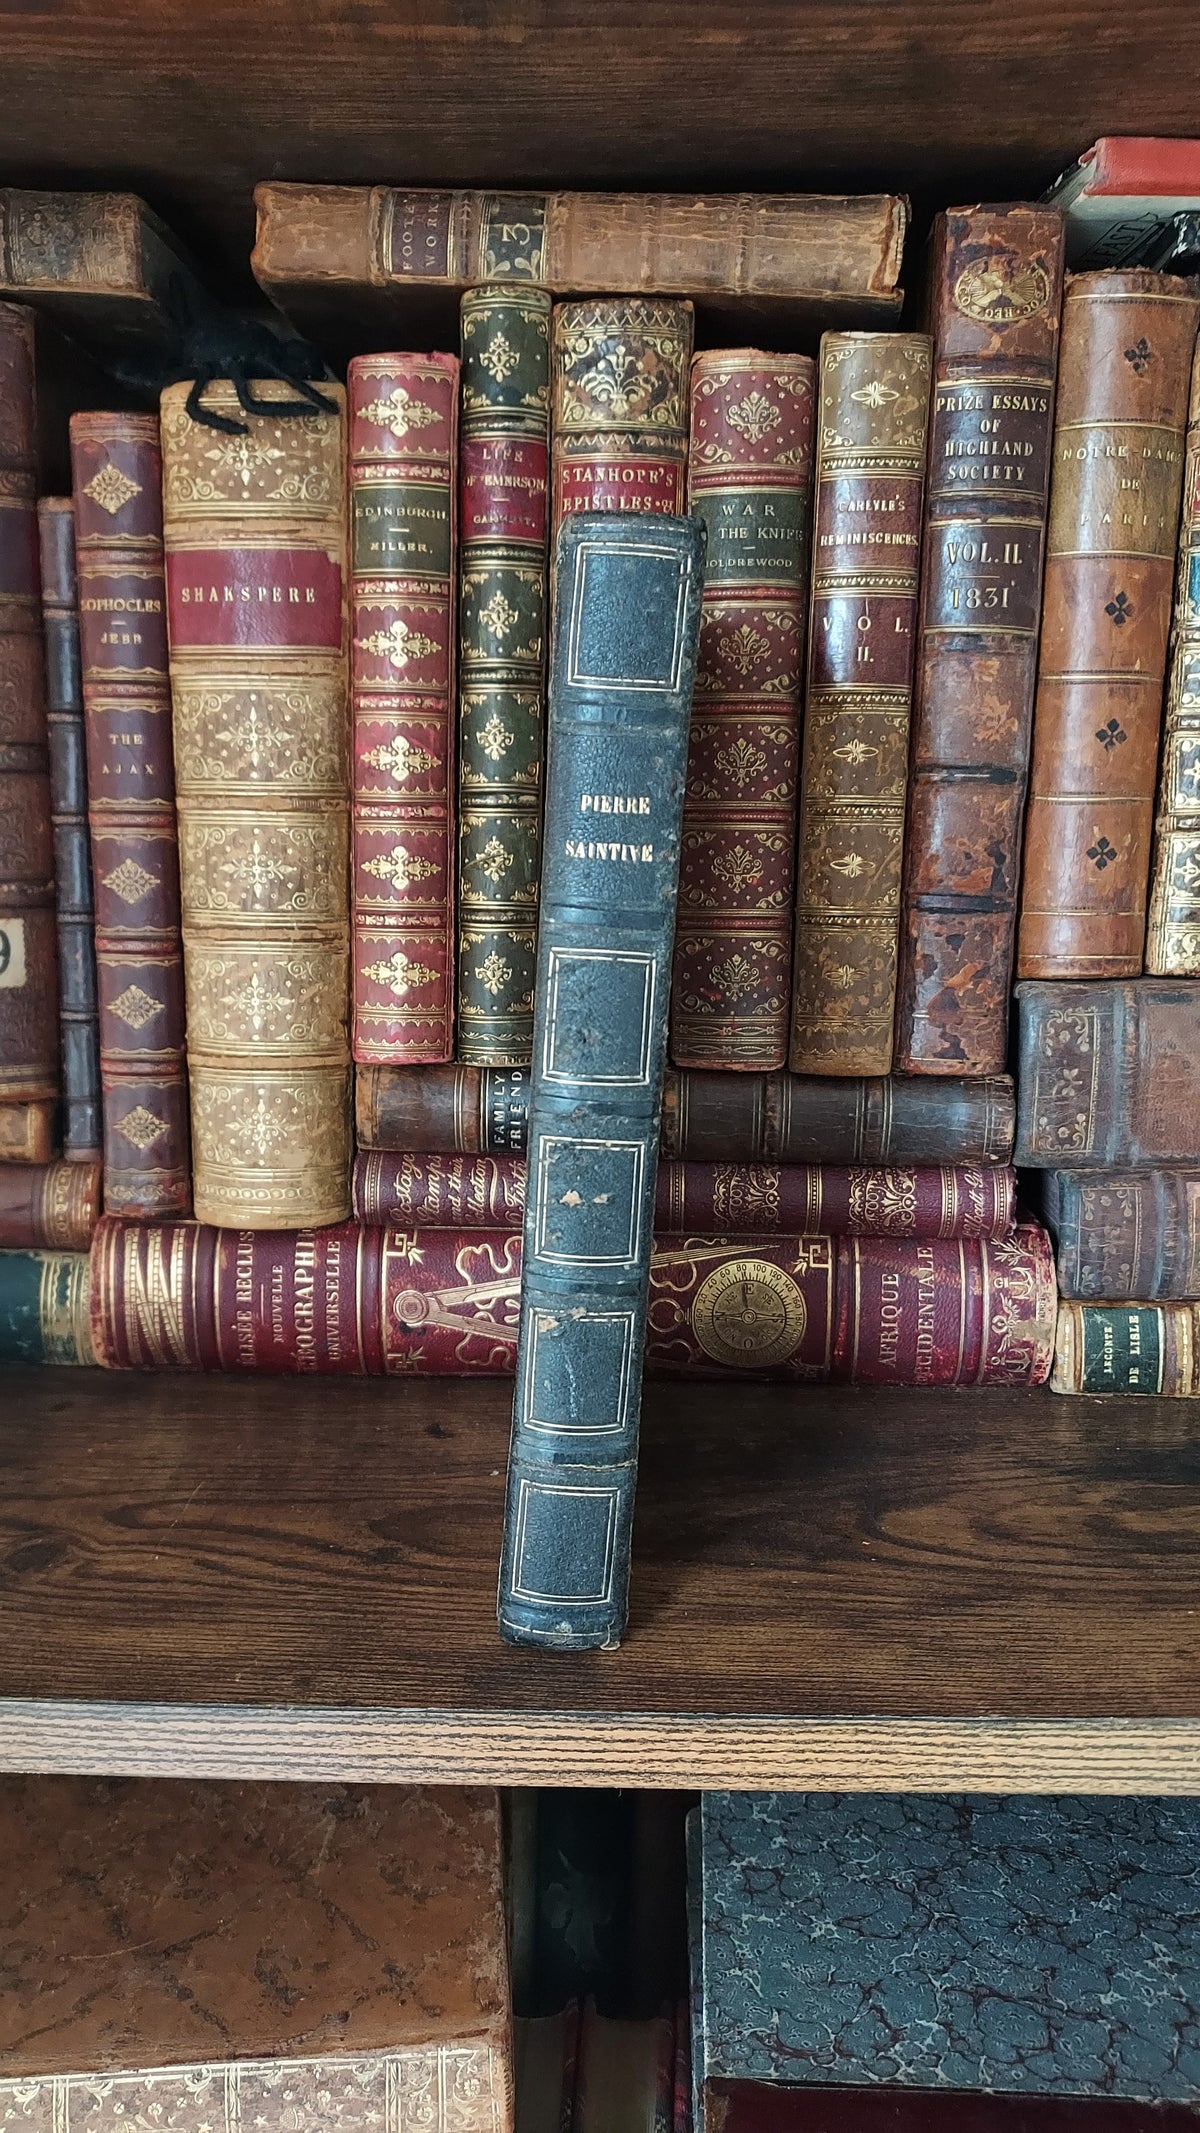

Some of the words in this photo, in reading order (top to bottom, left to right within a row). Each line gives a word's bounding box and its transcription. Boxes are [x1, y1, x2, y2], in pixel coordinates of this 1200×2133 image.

[425, 194, 440, 266] WORKS
[936, 394, 984, 412] PRIZE
[992, 395, 1047, 413] ESSAYS
[980, 419, 1001, 434] OF
[482, 448, 524, 462] LIFE
[944, 441, 1034, 458] HIGHLAND
[562, 467, 673, 486] STANHOPE'S
[947, 466, 1026, 481] SOCIETY
[1121, 479, 1141, 490] DE
[722, 504, 775, 517] WAR
[839, 494, 906, 512] CARLYLE'S
[1080, 514, 1164, 528] PARIS
[718, 528, 748, 540] THE
[757, 527, 803, 541] KNIFE
[181, 586, 316, 603] SHAKSPERE
[952, 587, 1009, 609] 1831
[81, 599, 161, 613] SOPHOCLES
[100, 632, 142, 645] JEBB
[857, 647, 874, 662] II.
[110, 734, 143, 745] THE
[102, 763, 154, 775] AJAX
[581, 794, 651, 814] PIERRE
[565, 840, 653, 862] SAINTIVE
[494, 1075, 505, 1143] FAMILY
[390, 1154, 423, 1224] Postage
[416, 1154, 446, 1224] Stamps
[464, 1158, 487, 1224] Collection
[236, 1231, 255, 1303] RECLUS
[719, 1268, 731, 1278] 60
[736, 1263, 747, 1272] 80
[753, 1264, 767, 1273] 100
[707, 1278, 718, 1289] 40
[782, 1279, 794, 1293] 140
[744, 1283, 755, 1295] E
[272, 1265, 284, 1343] NOUVELLE
[325, 1241, 341, 1360] UNIVERSELLE
[879, 1273, 902, 1368] AFRIQUE
[1129, 1315, 1140, 1355] LISLE
[1104, 1326, 1113, 1373] LECONTE
[1129, 1367, 1139, 1384] DE
